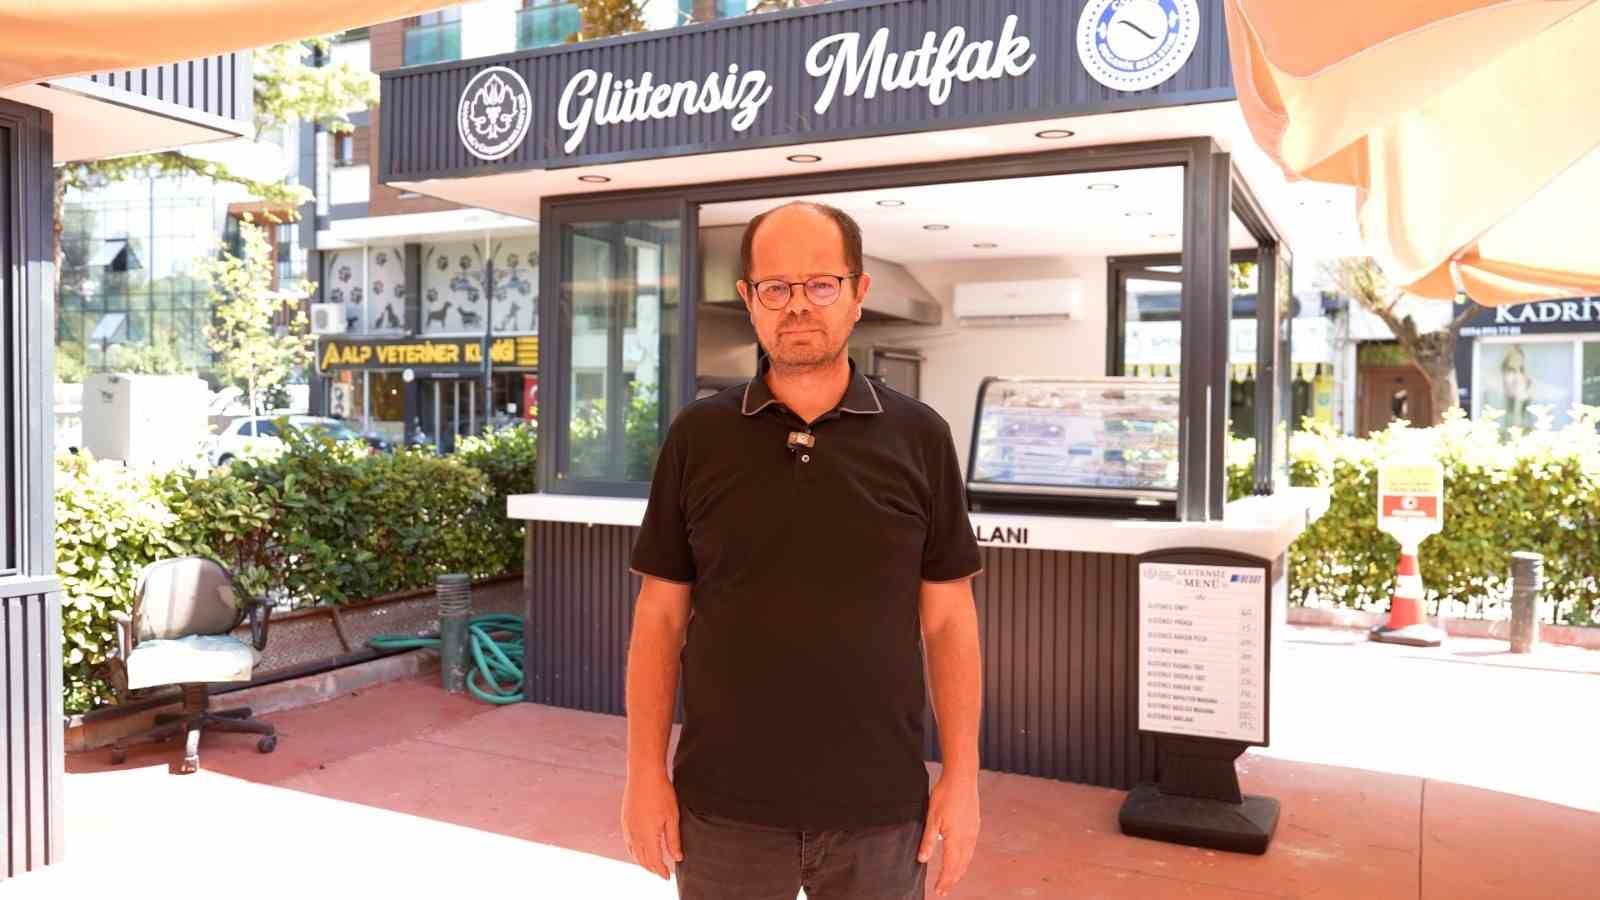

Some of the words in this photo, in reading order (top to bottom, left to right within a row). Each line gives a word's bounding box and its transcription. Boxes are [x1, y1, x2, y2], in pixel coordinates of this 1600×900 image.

[558, 64, 773, 154] Glütensiz
[805, 14, 1036, 114] Mutfak
[376, 341, 460, 362] VETERİNER
[976, 525, 1028, 544] LANI
